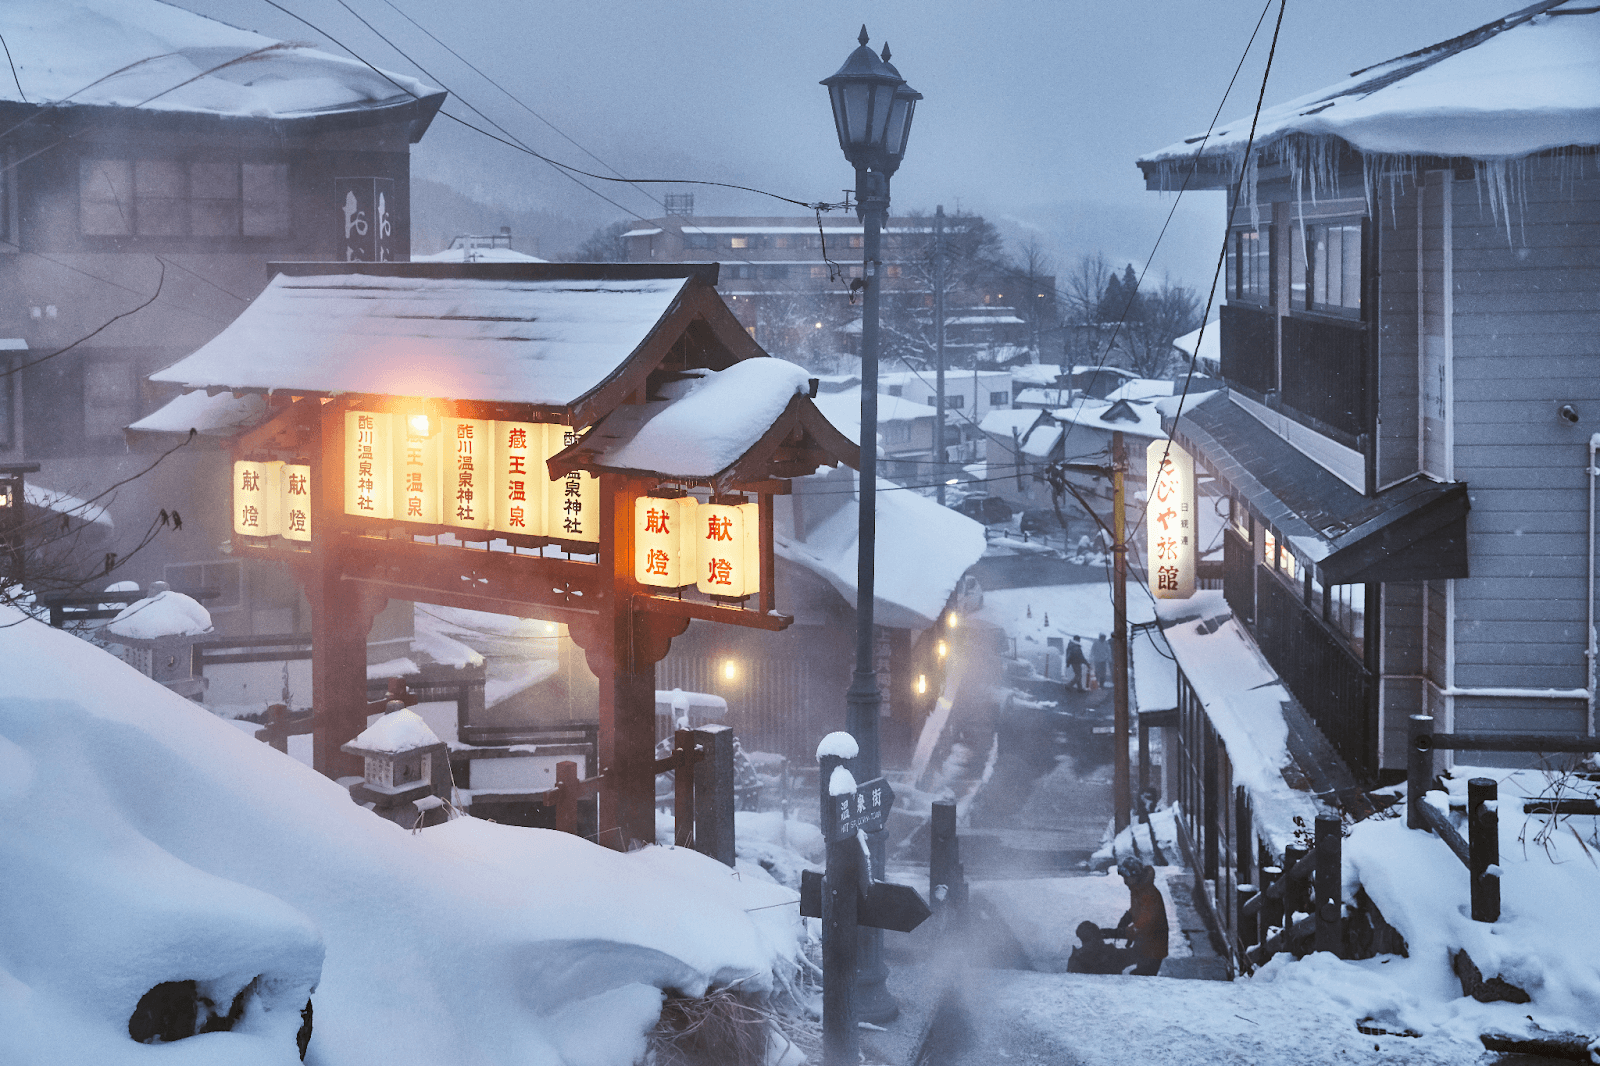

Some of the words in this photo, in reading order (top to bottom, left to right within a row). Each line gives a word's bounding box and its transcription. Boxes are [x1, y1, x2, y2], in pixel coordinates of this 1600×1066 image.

[241, 469, 260, 528] 献燈
[288, 473, 307, 532] 献燈
[358, 414, 374, 511] 酢川温泉神社
[406, 434, 424, 517] 王温泉
[456, 424, 475, 521] 酢川温泉神社
[508, 428, 527, 527] 蔵王温泉
[563, 431, 583, 534] 酢泉神社
[644, 507, 670, 576] 献燈
[706, 514, 733, 586] 献燈
[1156, 451, 1179, 591] えびや旅館
[840, 787, 882, 821] 温泉街
